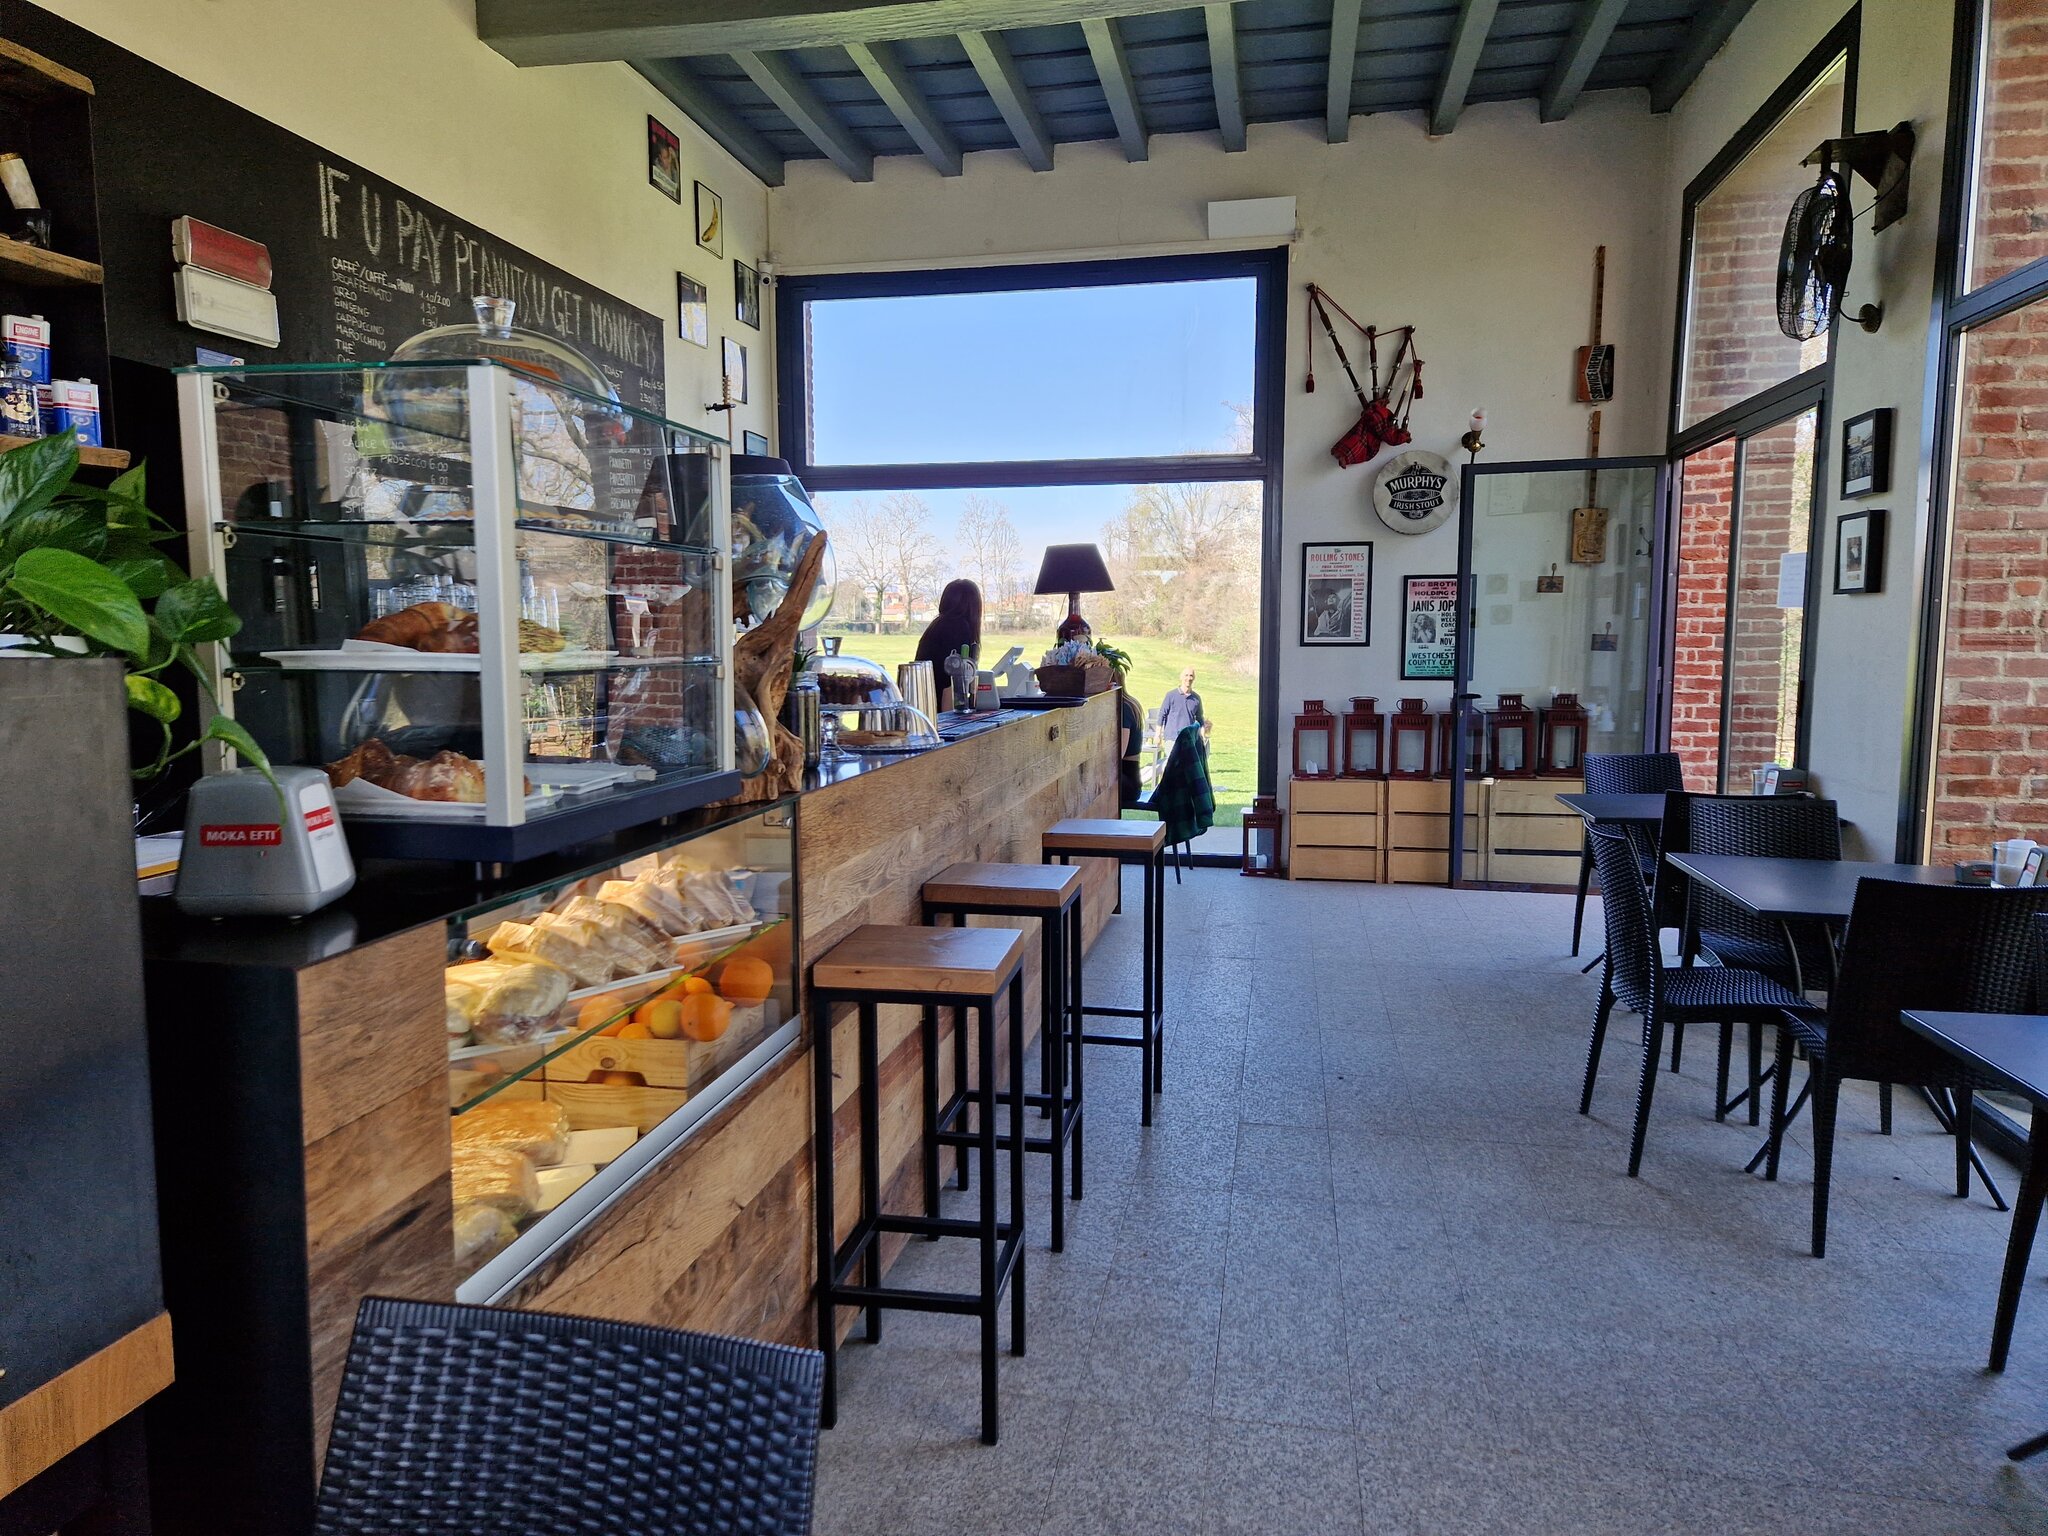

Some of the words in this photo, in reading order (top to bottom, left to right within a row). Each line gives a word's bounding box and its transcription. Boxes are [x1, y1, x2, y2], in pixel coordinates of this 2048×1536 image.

[319, 161, 350, 240] IF
[361, 183, 382, 257] U
[396, 199, 447, 286] PAY
[550, 285, 583, 342] GET
[590, 301, 657, 375] MONKEYS
[15, 324, 39, 337] ENGINE
[1587, 346, 1606, 370] REPAIR
[1586, 372, 1604, 399] SERVICE
[69, 390, 91, 403] ENGINE
[1393, 500, 1415, 510] IRISH
[1416, 499, 1440, 510] STOUT
[1310, 553, 1338, 562] ROLLING
[1340, 552, 1365, 562] STONES
[1411, 600, 1435, 612] JANIS
[206, 830, 247, 841] MOKA
[250, 829, 277, 841] EFTI
